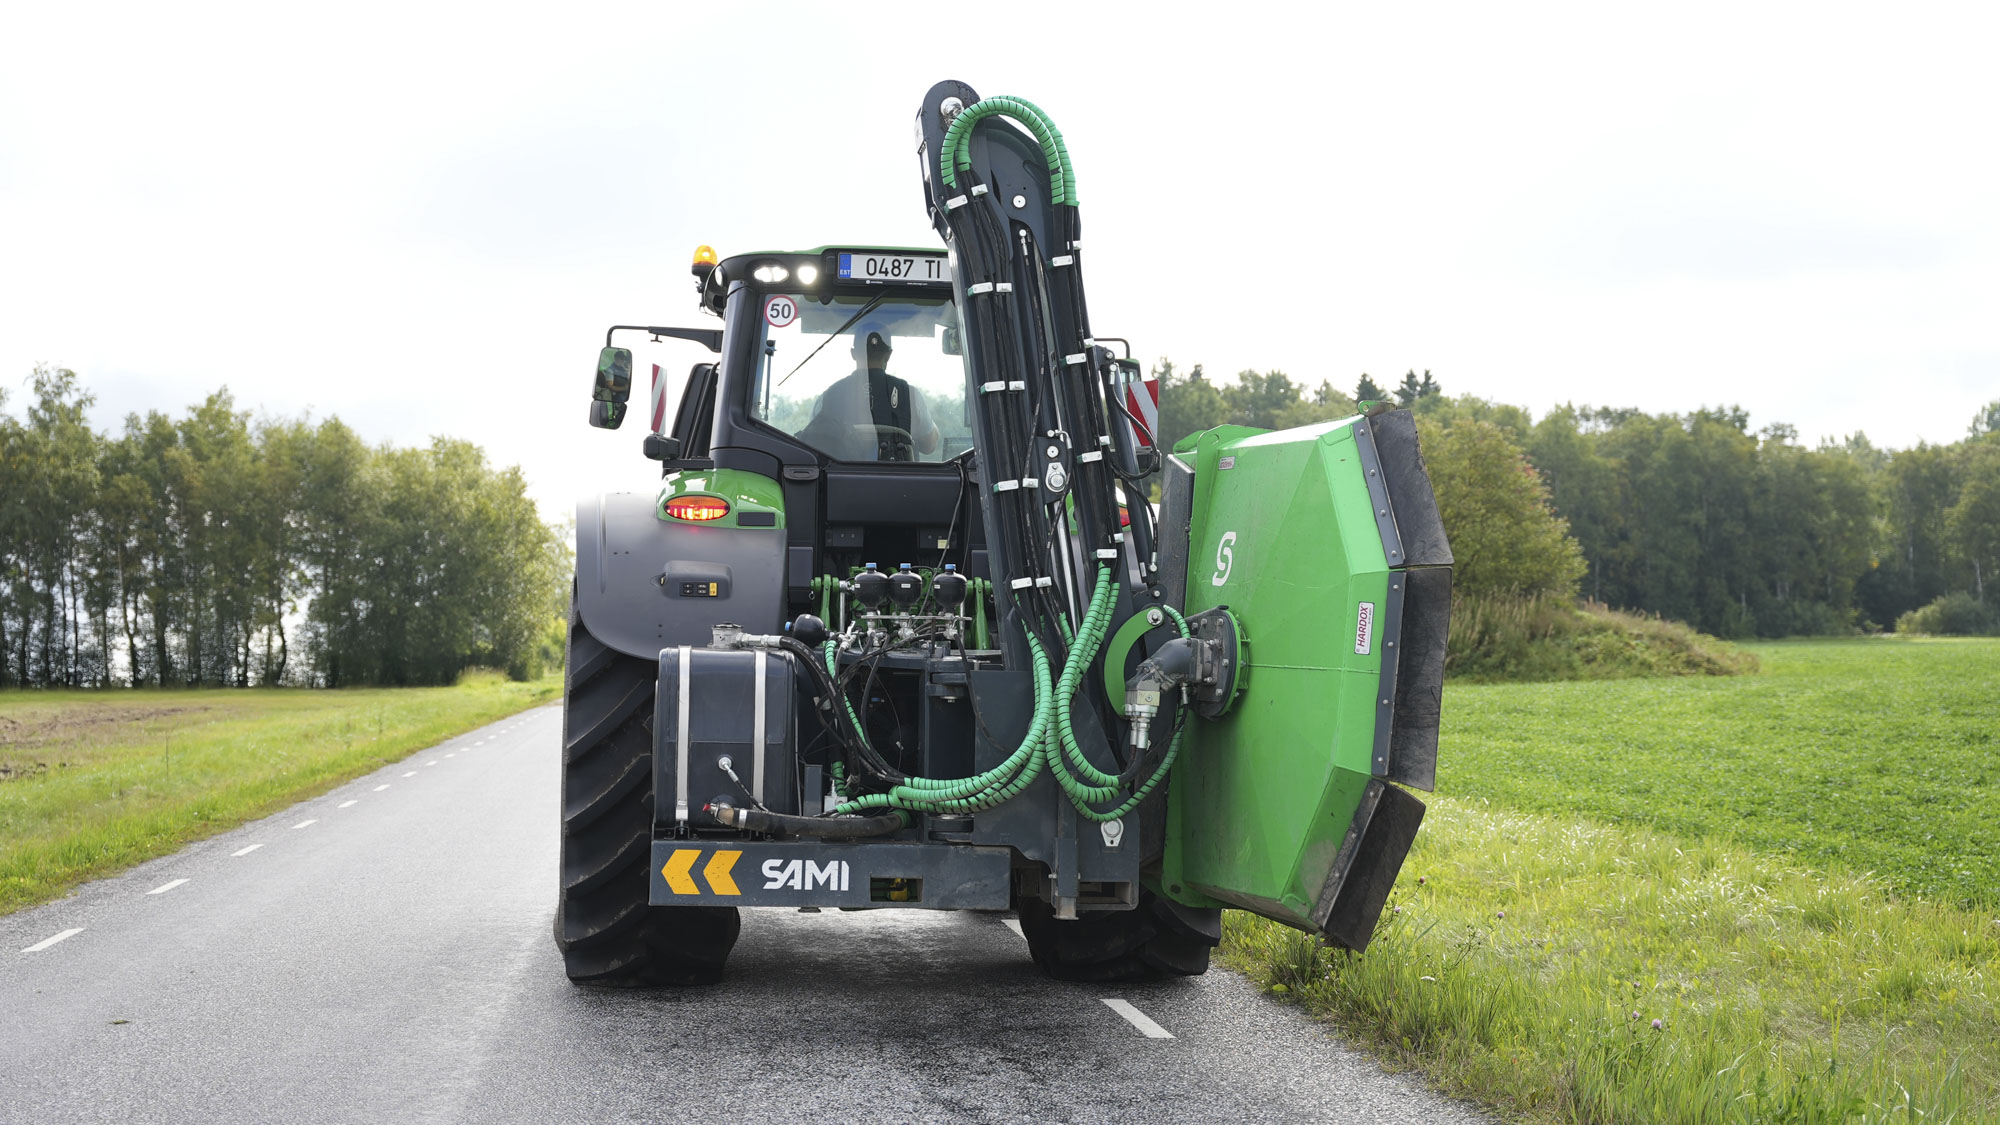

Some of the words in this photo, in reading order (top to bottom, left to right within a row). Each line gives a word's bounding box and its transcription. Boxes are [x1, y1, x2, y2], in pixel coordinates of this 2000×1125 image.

[866, 258, 914, 277] 0487
[925, 260, 940, 278] TI
[770, 303, 792, 319] 50
[1357, 606, 1368, 647] HARDOX
[762, 859, 849, 891] SAMI
